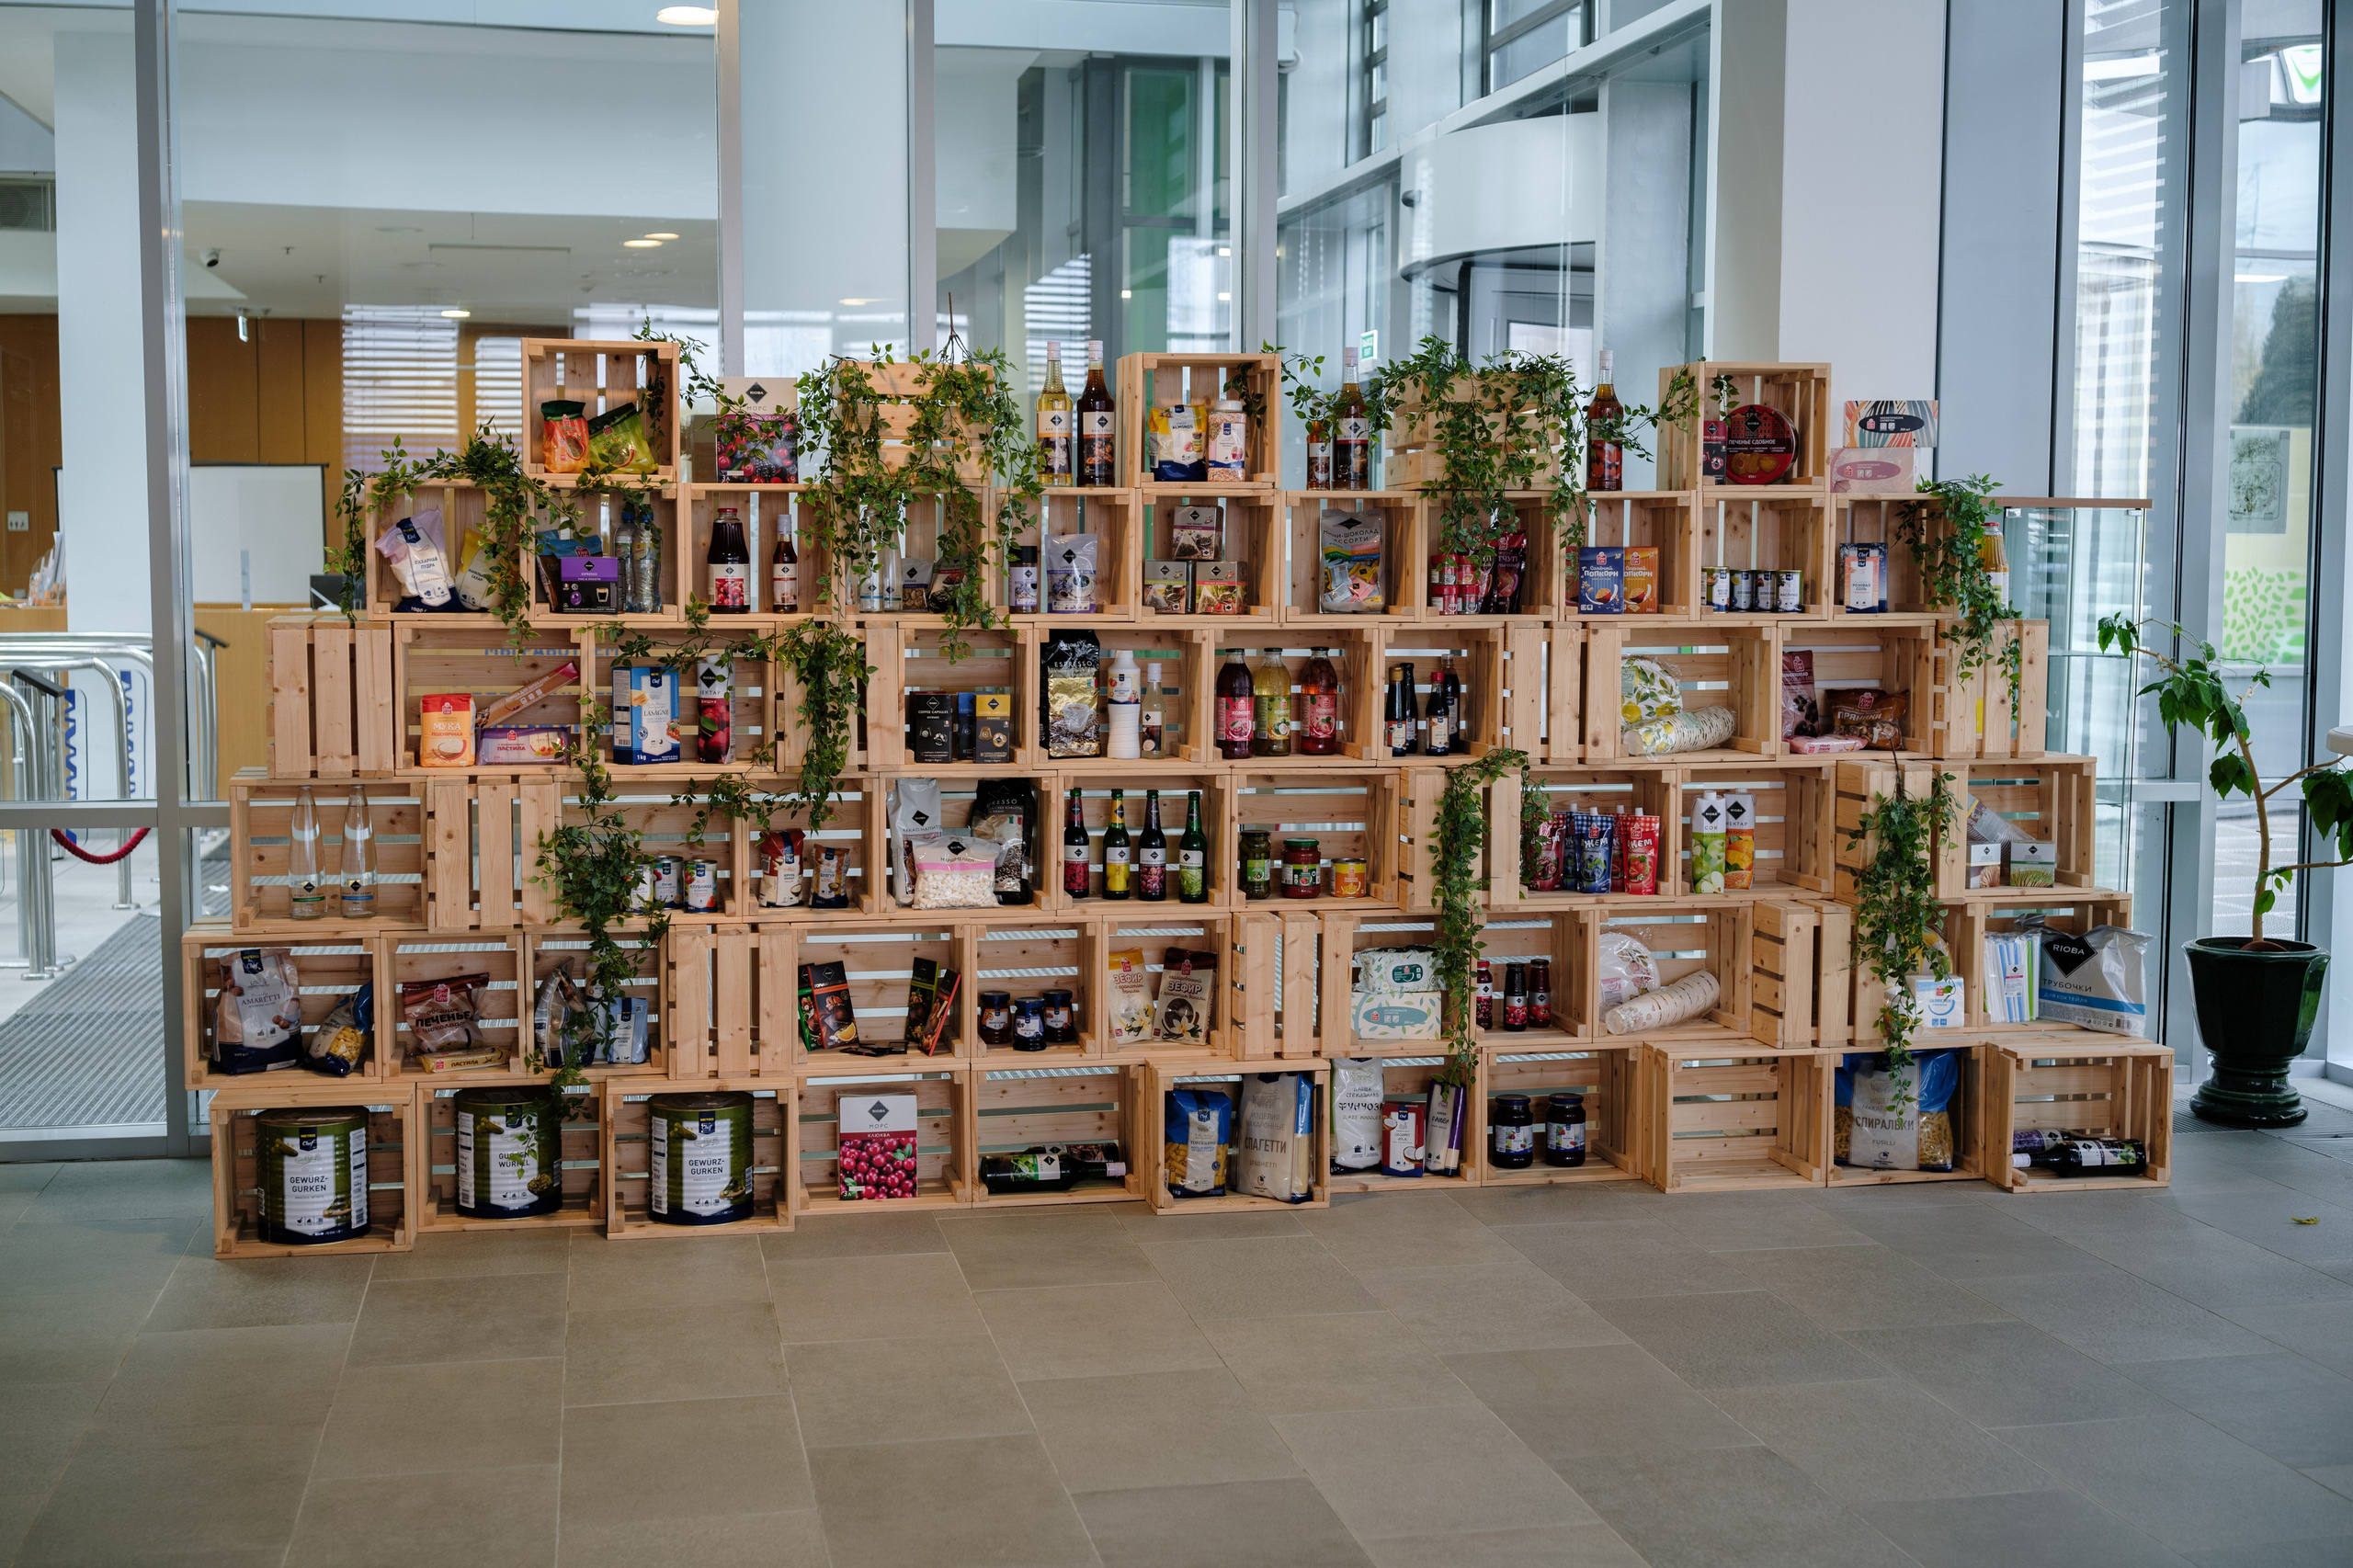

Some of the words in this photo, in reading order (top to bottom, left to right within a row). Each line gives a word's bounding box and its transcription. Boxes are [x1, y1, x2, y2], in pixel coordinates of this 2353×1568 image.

[414, 557, 438, 565] САХАРНАЯ
[1836, 711, 1882, 721] ПРЯНИКИ
[433, 722, 461, 731] МУКА
[2052, 943, 2086, 956] RIOBA
[1113, 973, 1142, 984] ЗЕФИР
[1167, 980, 1202, 994] ЗЕФИР
[2042, 979, 2092, 993] ТРУБОЧКИ
[2056, 994, 2088, 1004] КОКТЕЙЛЯ
[415, 1011, 471, 1028] ПЕЧЕНЬЕ
[450, 1060, 479, 1068] ПАСТИЛА
[1251, 1111, 1280, 1121] ИЗДЕЛИЯ
[1246, 1119, 1286, 1131] МАКАРОННЫЕ
[1855, 1116, 1915, 1131] СПИРАЛЬКИ
[1245, 1136, 1287, 1153] СПАГЕТТИ
[688, 1158, 725, 1166] GEWÜRZ-
[1249, 1159, 1278, 1169] SPAGHETTI
[290, 1175, 328, 1184] GEWÜRZ-
[291, 1185, 327, 1193] GURKEN
